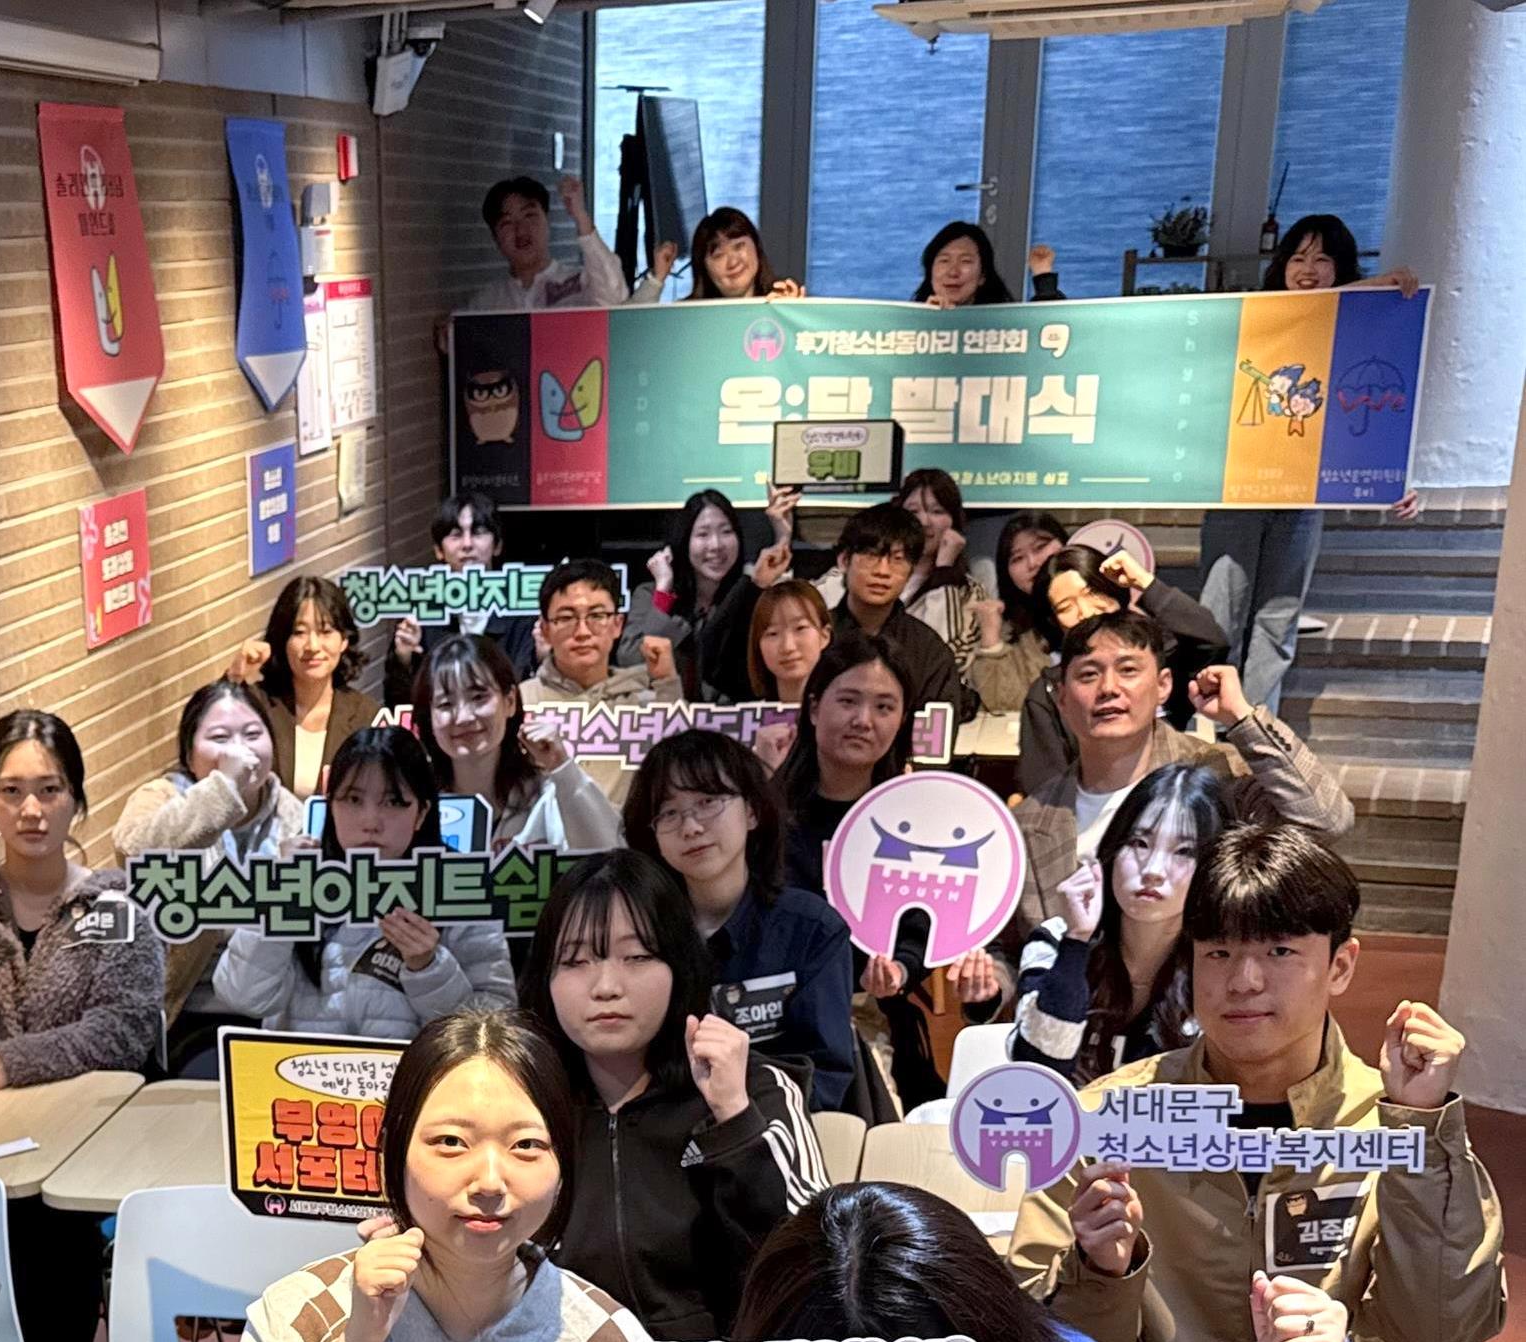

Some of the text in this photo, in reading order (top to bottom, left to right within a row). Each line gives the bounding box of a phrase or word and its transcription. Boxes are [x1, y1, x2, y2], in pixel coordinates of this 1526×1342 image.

[963, 329, 1029, 354] 연합회
[891, 374, 1100, 444] 발대식
[342, 566, 548, 622] 청소년아지트
[132, 852, 575, 936] 청소년아지트쉼
[883, 883, 961, 902] YOUTH
[735, 1000, 784, 1025] 조아인
[290, 1059, 329, 1078] 청소년
[333, 1060, 376, 1080] 디지털
[321, 1077, 352, 1096] 예방
[1097, 1088, 1239, 1124] 서대문구
[989, 1140, 1043, 1148] YOUTH
[1096, 1130, 1424, 1171] 청소년상담복지센터
[252, 1141, 383, 1197] 서포터
